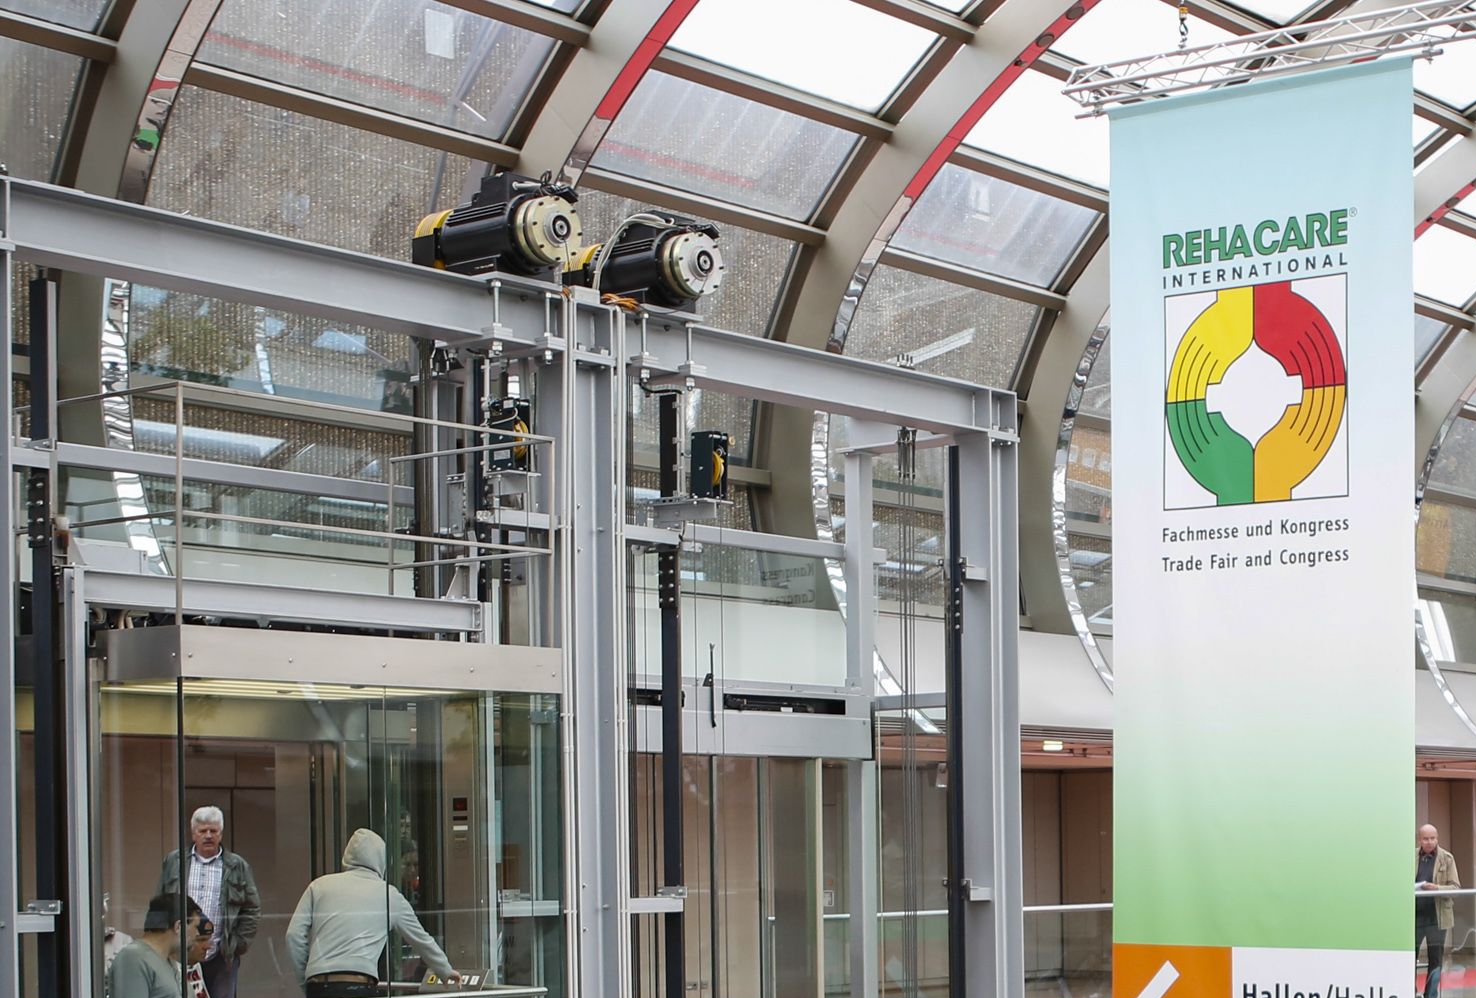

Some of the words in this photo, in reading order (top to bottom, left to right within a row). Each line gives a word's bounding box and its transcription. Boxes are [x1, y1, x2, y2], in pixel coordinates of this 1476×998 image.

[1163, 253, 1348, 289] INTERNATIONAL
[1162, 525, 1239, 543] Fachmesse
[1246, 519, 1272, 538] und
[1281, 517, 1350, 540] Kongress
[1162, 554, 1203, 572] Trade
[1211, 552, 1238, 570] Fair
[1245, 549, 1272, 568] and
[1280, 547, 1350, 569] Congress
